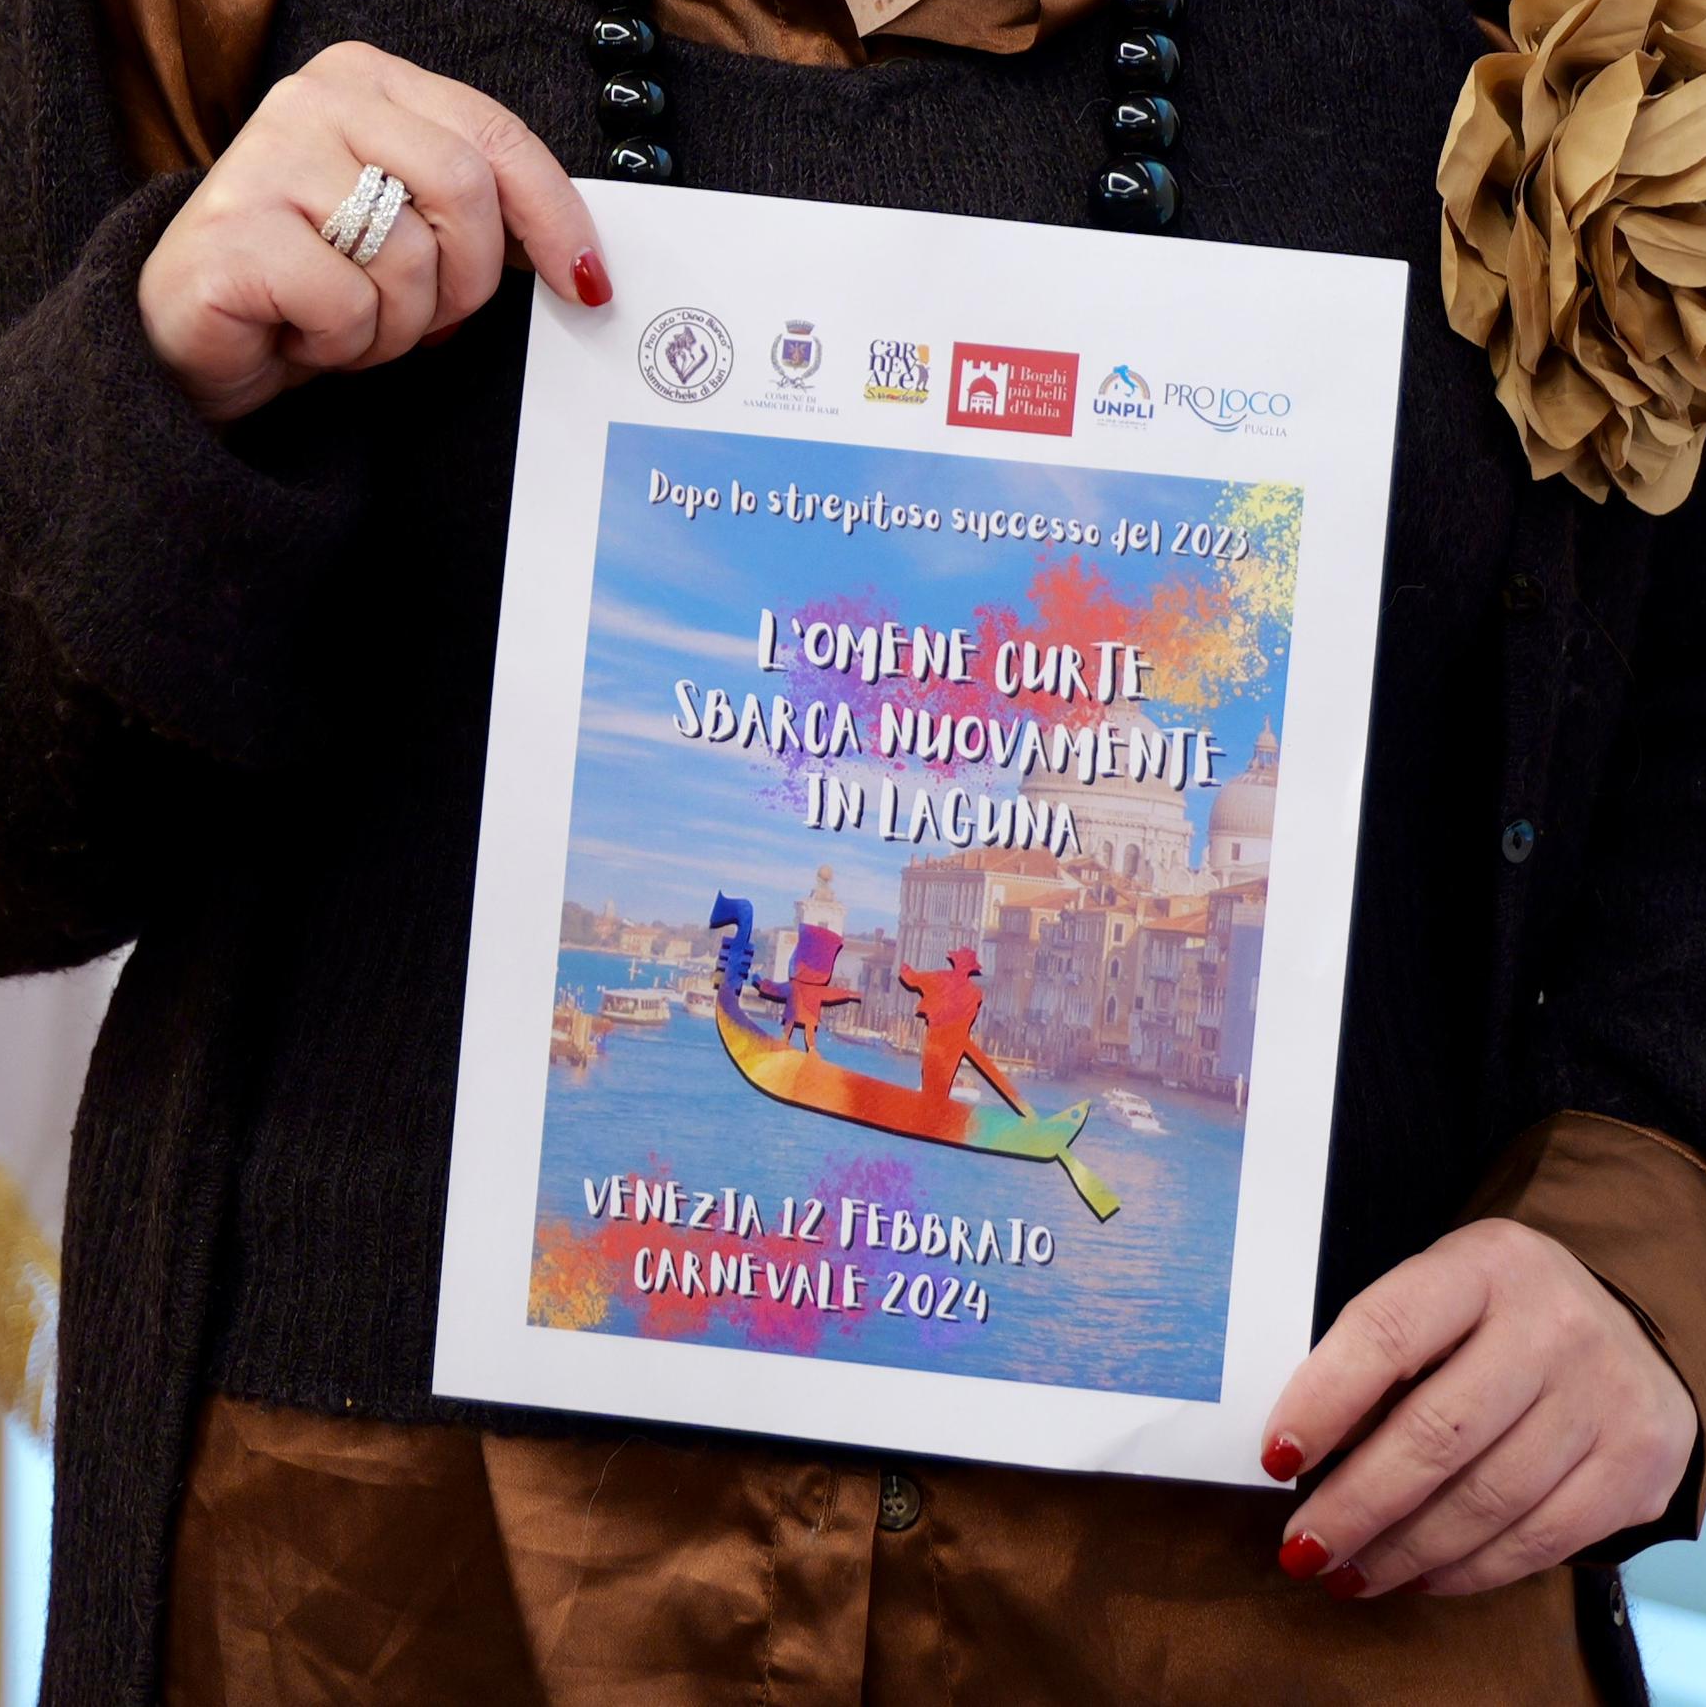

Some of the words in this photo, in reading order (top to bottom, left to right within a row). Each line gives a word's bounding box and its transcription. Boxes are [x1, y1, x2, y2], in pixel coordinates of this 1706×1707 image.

[645, 333, 657, 350] Pro
[653, 315, 675, 333] Loco
[644, 364, 698, 400] Sammichele
[700, 385, 711, 398] di
[710, 368, 727, 390] Bari
[1009, 366, 1015, 379] I
[1020, 366, 1067, 384] Borghi
[764, 392, 805, 403] COMUNE
[806, 395, 817, 404] DI
[1007, 385, 1031, 400] più
[1035, 385, 1068, 402] belli
[1009, 399, 1061, 418] d'Italia
[1093, 398, 1154, 419] UNPLI
[1164, 383, 1215, 410] PRO
[1219, 388, 1291, 420] LOCO
[1244, 423, 1288, 438] PUGLIA
[648, 467, 721, 520] Dopo
[731, 479, 758, 516] lo
[767, 481, 942, 535] strepitoso
[951, 507, 1101, 546] successo
[1110, 517, 1161, 556] del
[1170, 521, 1251, 560] 2023
[757, 607, 979, 684] L'OMENE
[994, 640, 1158, 705] CURTE
[672, 678, 861, 757] SBARCA
[879, 701, 1227, 790] NUOVAMENTE
[803, 770, 864, 831] IN
[878, 775, 1082, 857] LAGUNA
[583, 1174, 763, 1241] VENEZIA
[778, 1197, 825, 1243] 12
[839, 1197, 1055, 1266] FEBBRAIO
[633, 1246, 869, 1311] CARNEVALE
[881, 1269, 990, 1323] 2024
